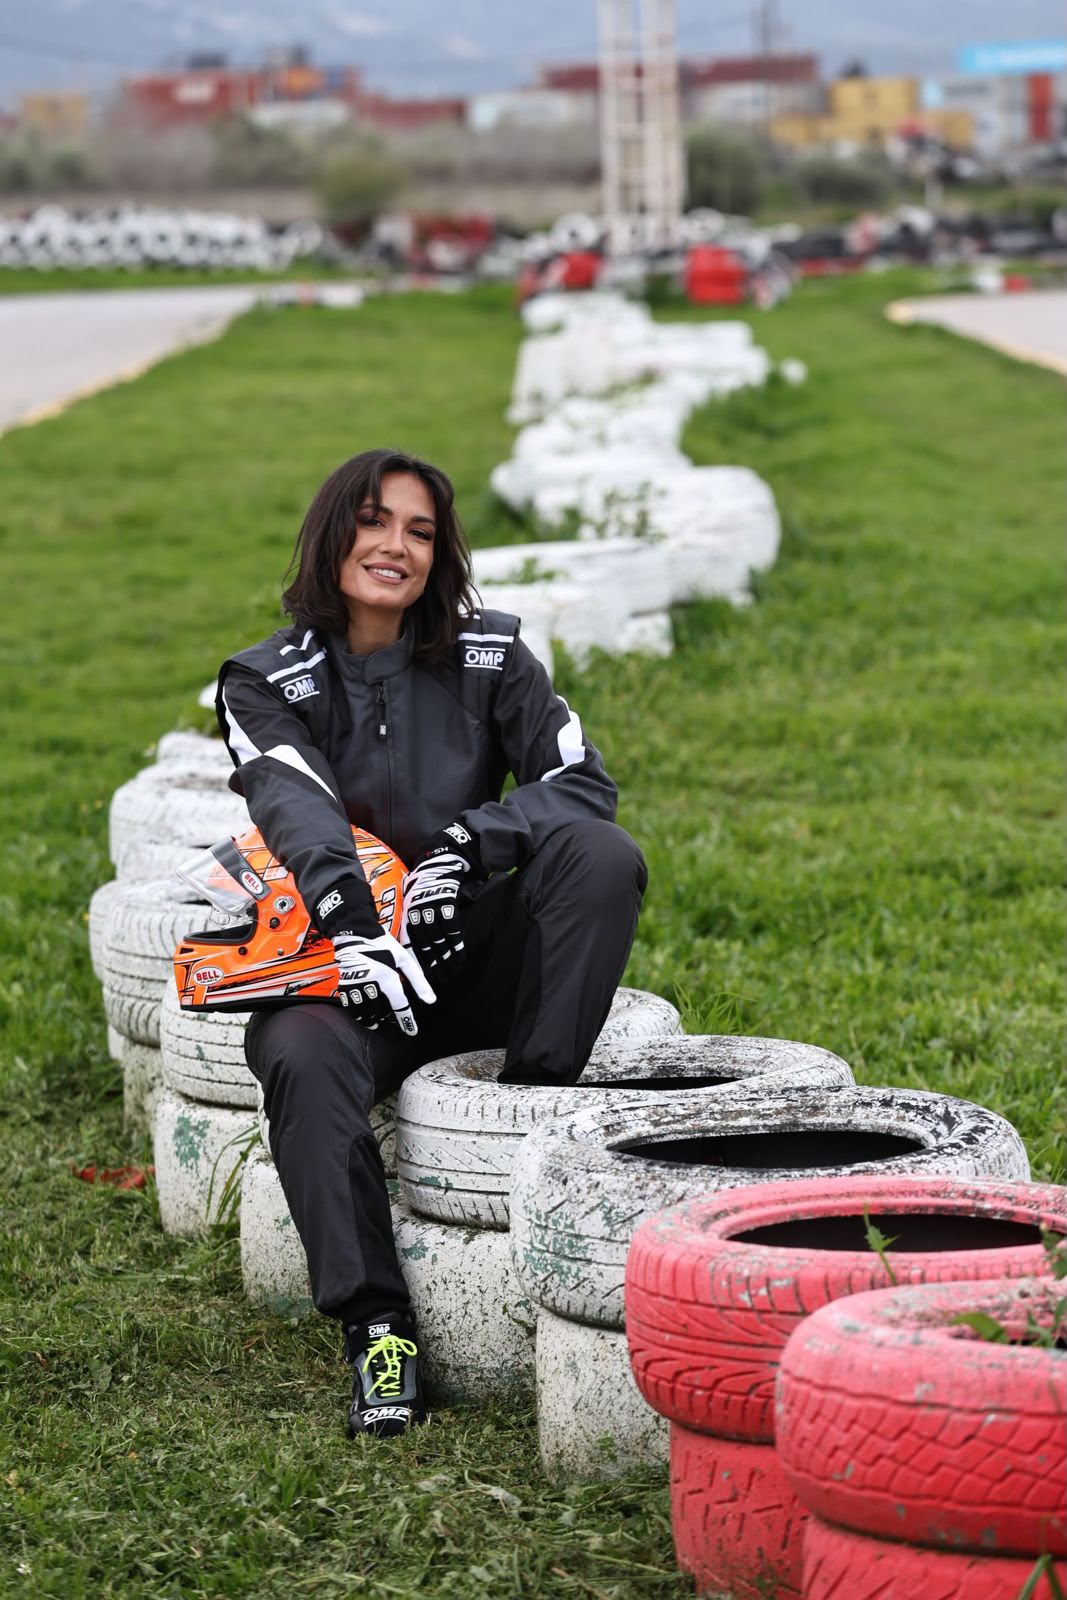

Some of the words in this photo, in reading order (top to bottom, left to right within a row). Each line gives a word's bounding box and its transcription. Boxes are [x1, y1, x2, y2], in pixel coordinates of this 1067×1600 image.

[466, 650, 504, 666] OMP
[283, 678, 315, 700] OMP
[446, 825, 468, 844] OMP
[244, 874, 260, 891] BELL
[411, 887, 456, 902] OMP
[319, 893, 341, 917] OMP
[196, 970, 220, 982] BELL
[403, 1016, 413, 1032] OMP
[368, 1326, 391, 1336] OMP
[363, 1407, 410, 1421] OMP
